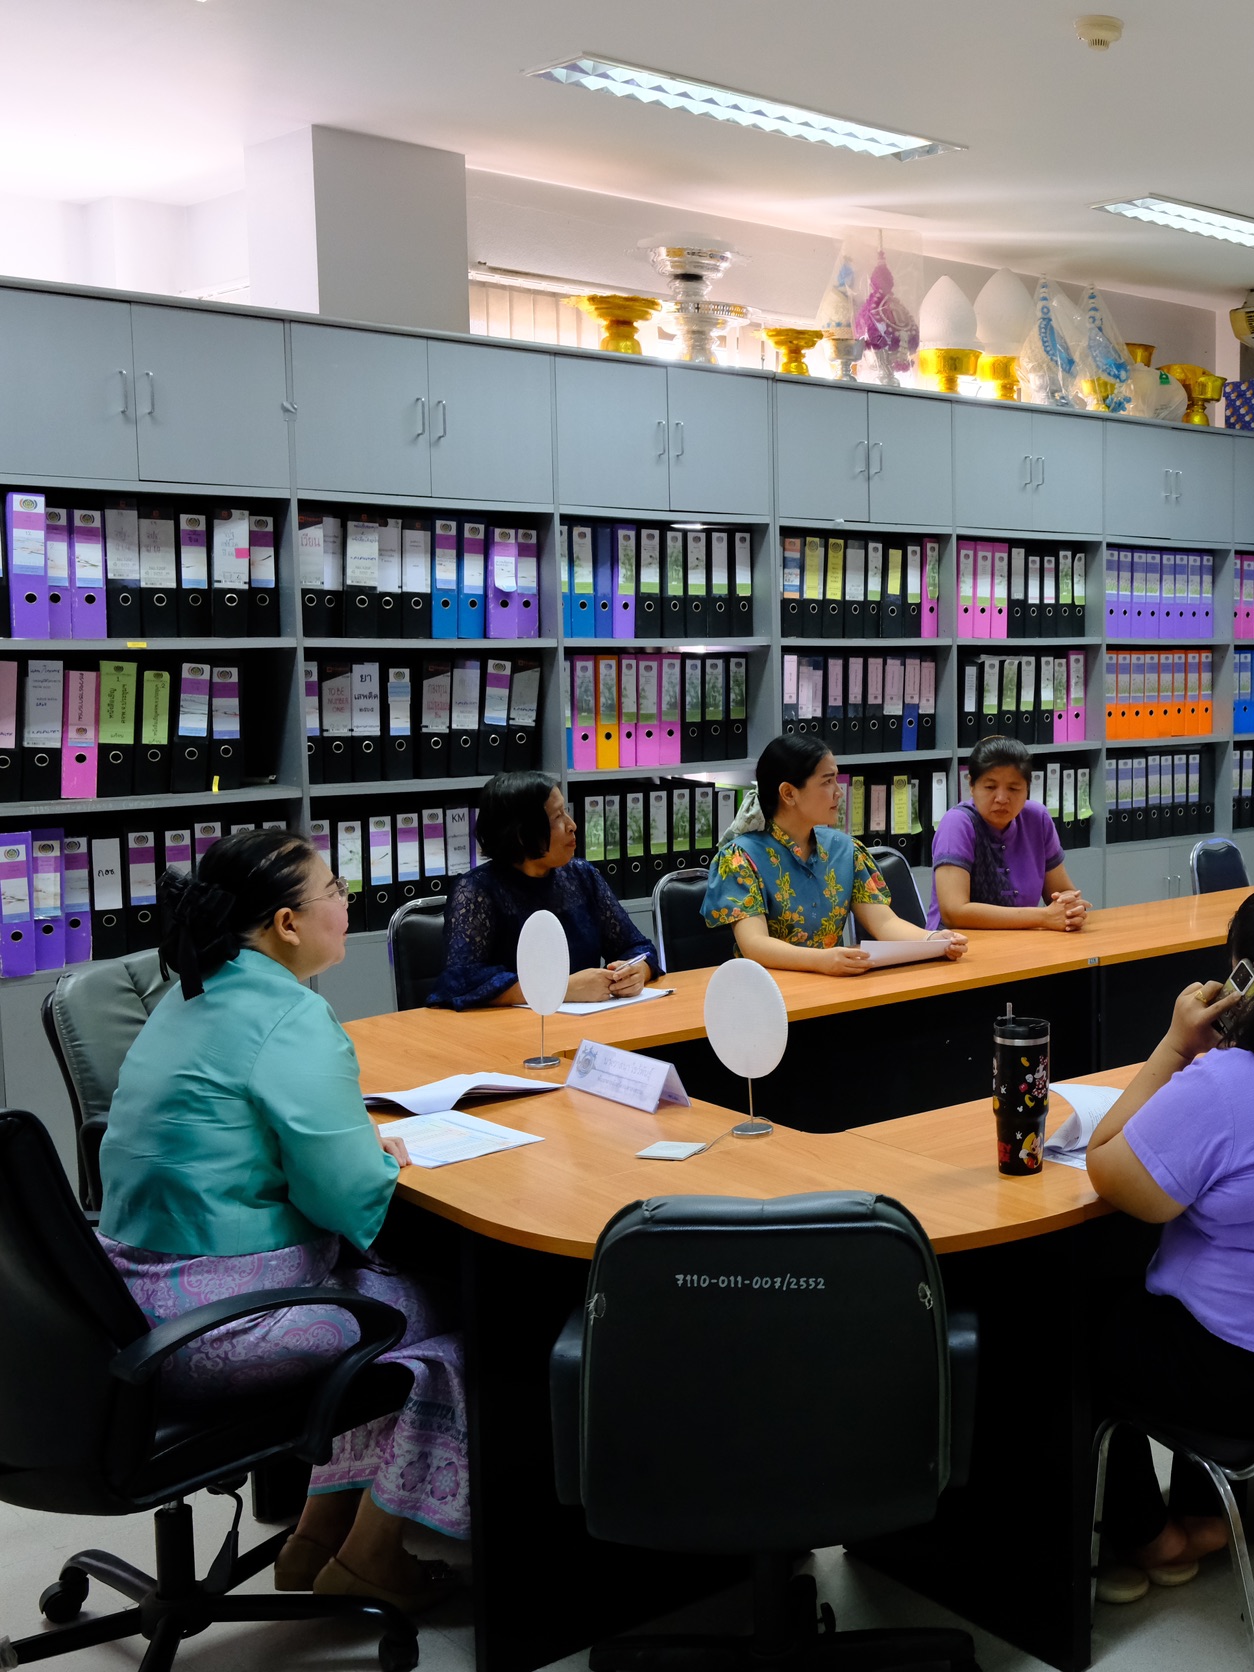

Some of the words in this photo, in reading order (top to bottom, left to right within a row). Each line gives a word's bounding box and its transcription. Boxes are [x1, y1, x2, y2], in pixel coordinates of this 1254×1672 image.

[300, 532, 321, 548] เวียน
[359, 674, 372, 683] ยา
[327, 687, 336, 696] TO
[336, 687, 345, 696] BE
[327, 697, 349, 705] NUMBER
[451, 812, 466, 824] KM
[675, 1273, 826, 1291] 7110-011-007/2552
